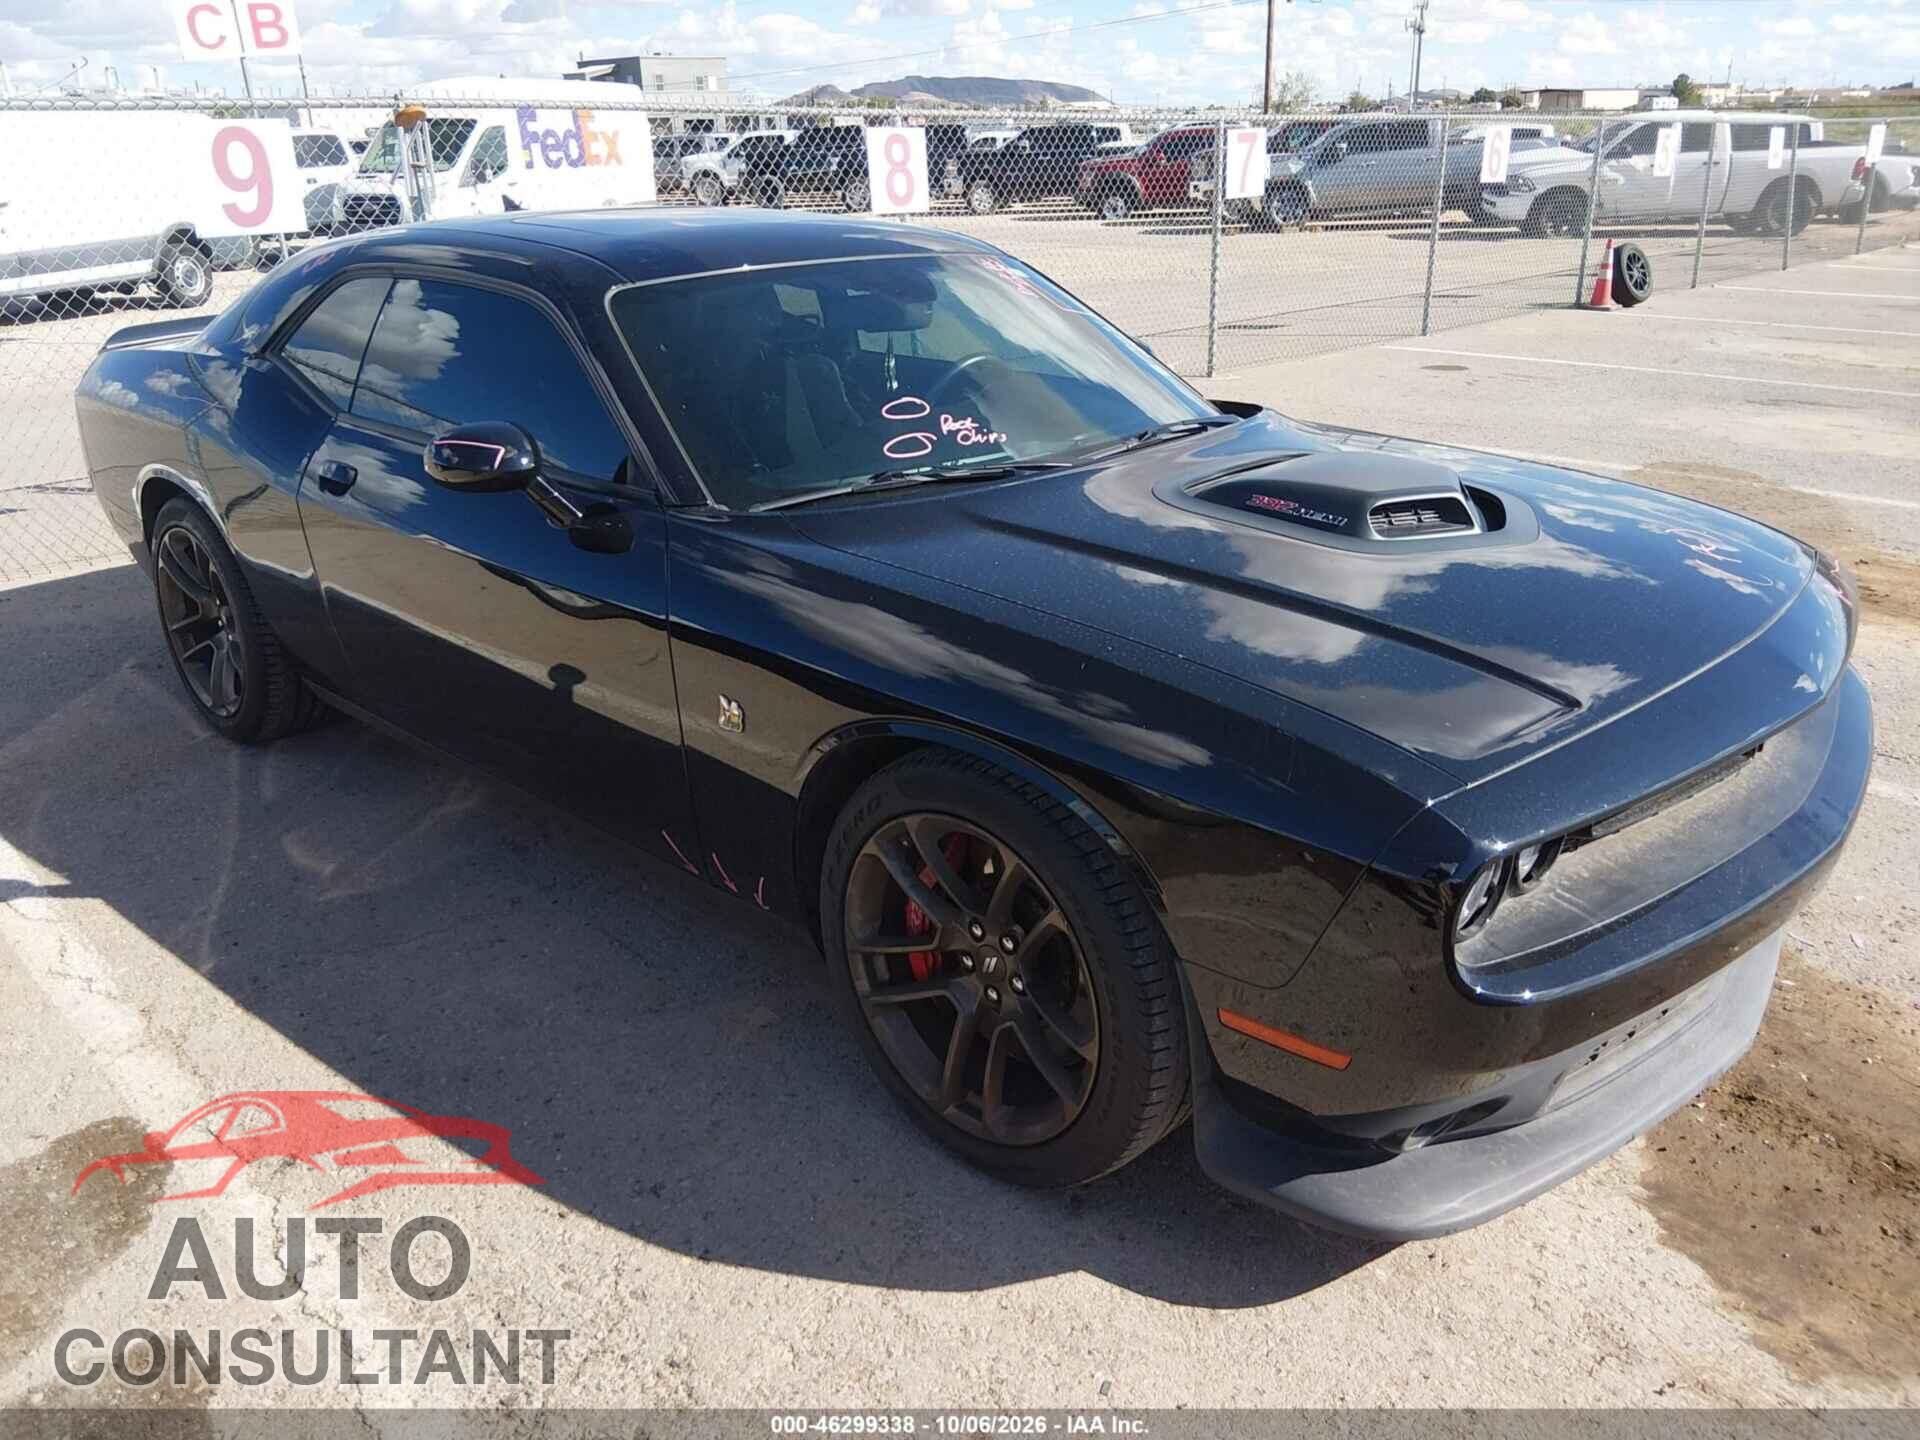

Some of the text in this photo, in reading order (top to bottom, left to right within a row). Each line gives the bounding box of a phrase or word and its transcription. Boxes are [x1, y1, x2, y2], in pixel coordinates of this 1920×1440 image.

[187, 4, 226, 49] C
[247, 3, 288, 48] B
[516, 103, 622, 169] FedEx
[1237, 132, 1257, 193] 7
[1488, 130, 1504, 178] 6
[211, 126, 273, 227] 9
[884, 133, 914, 207] 8
